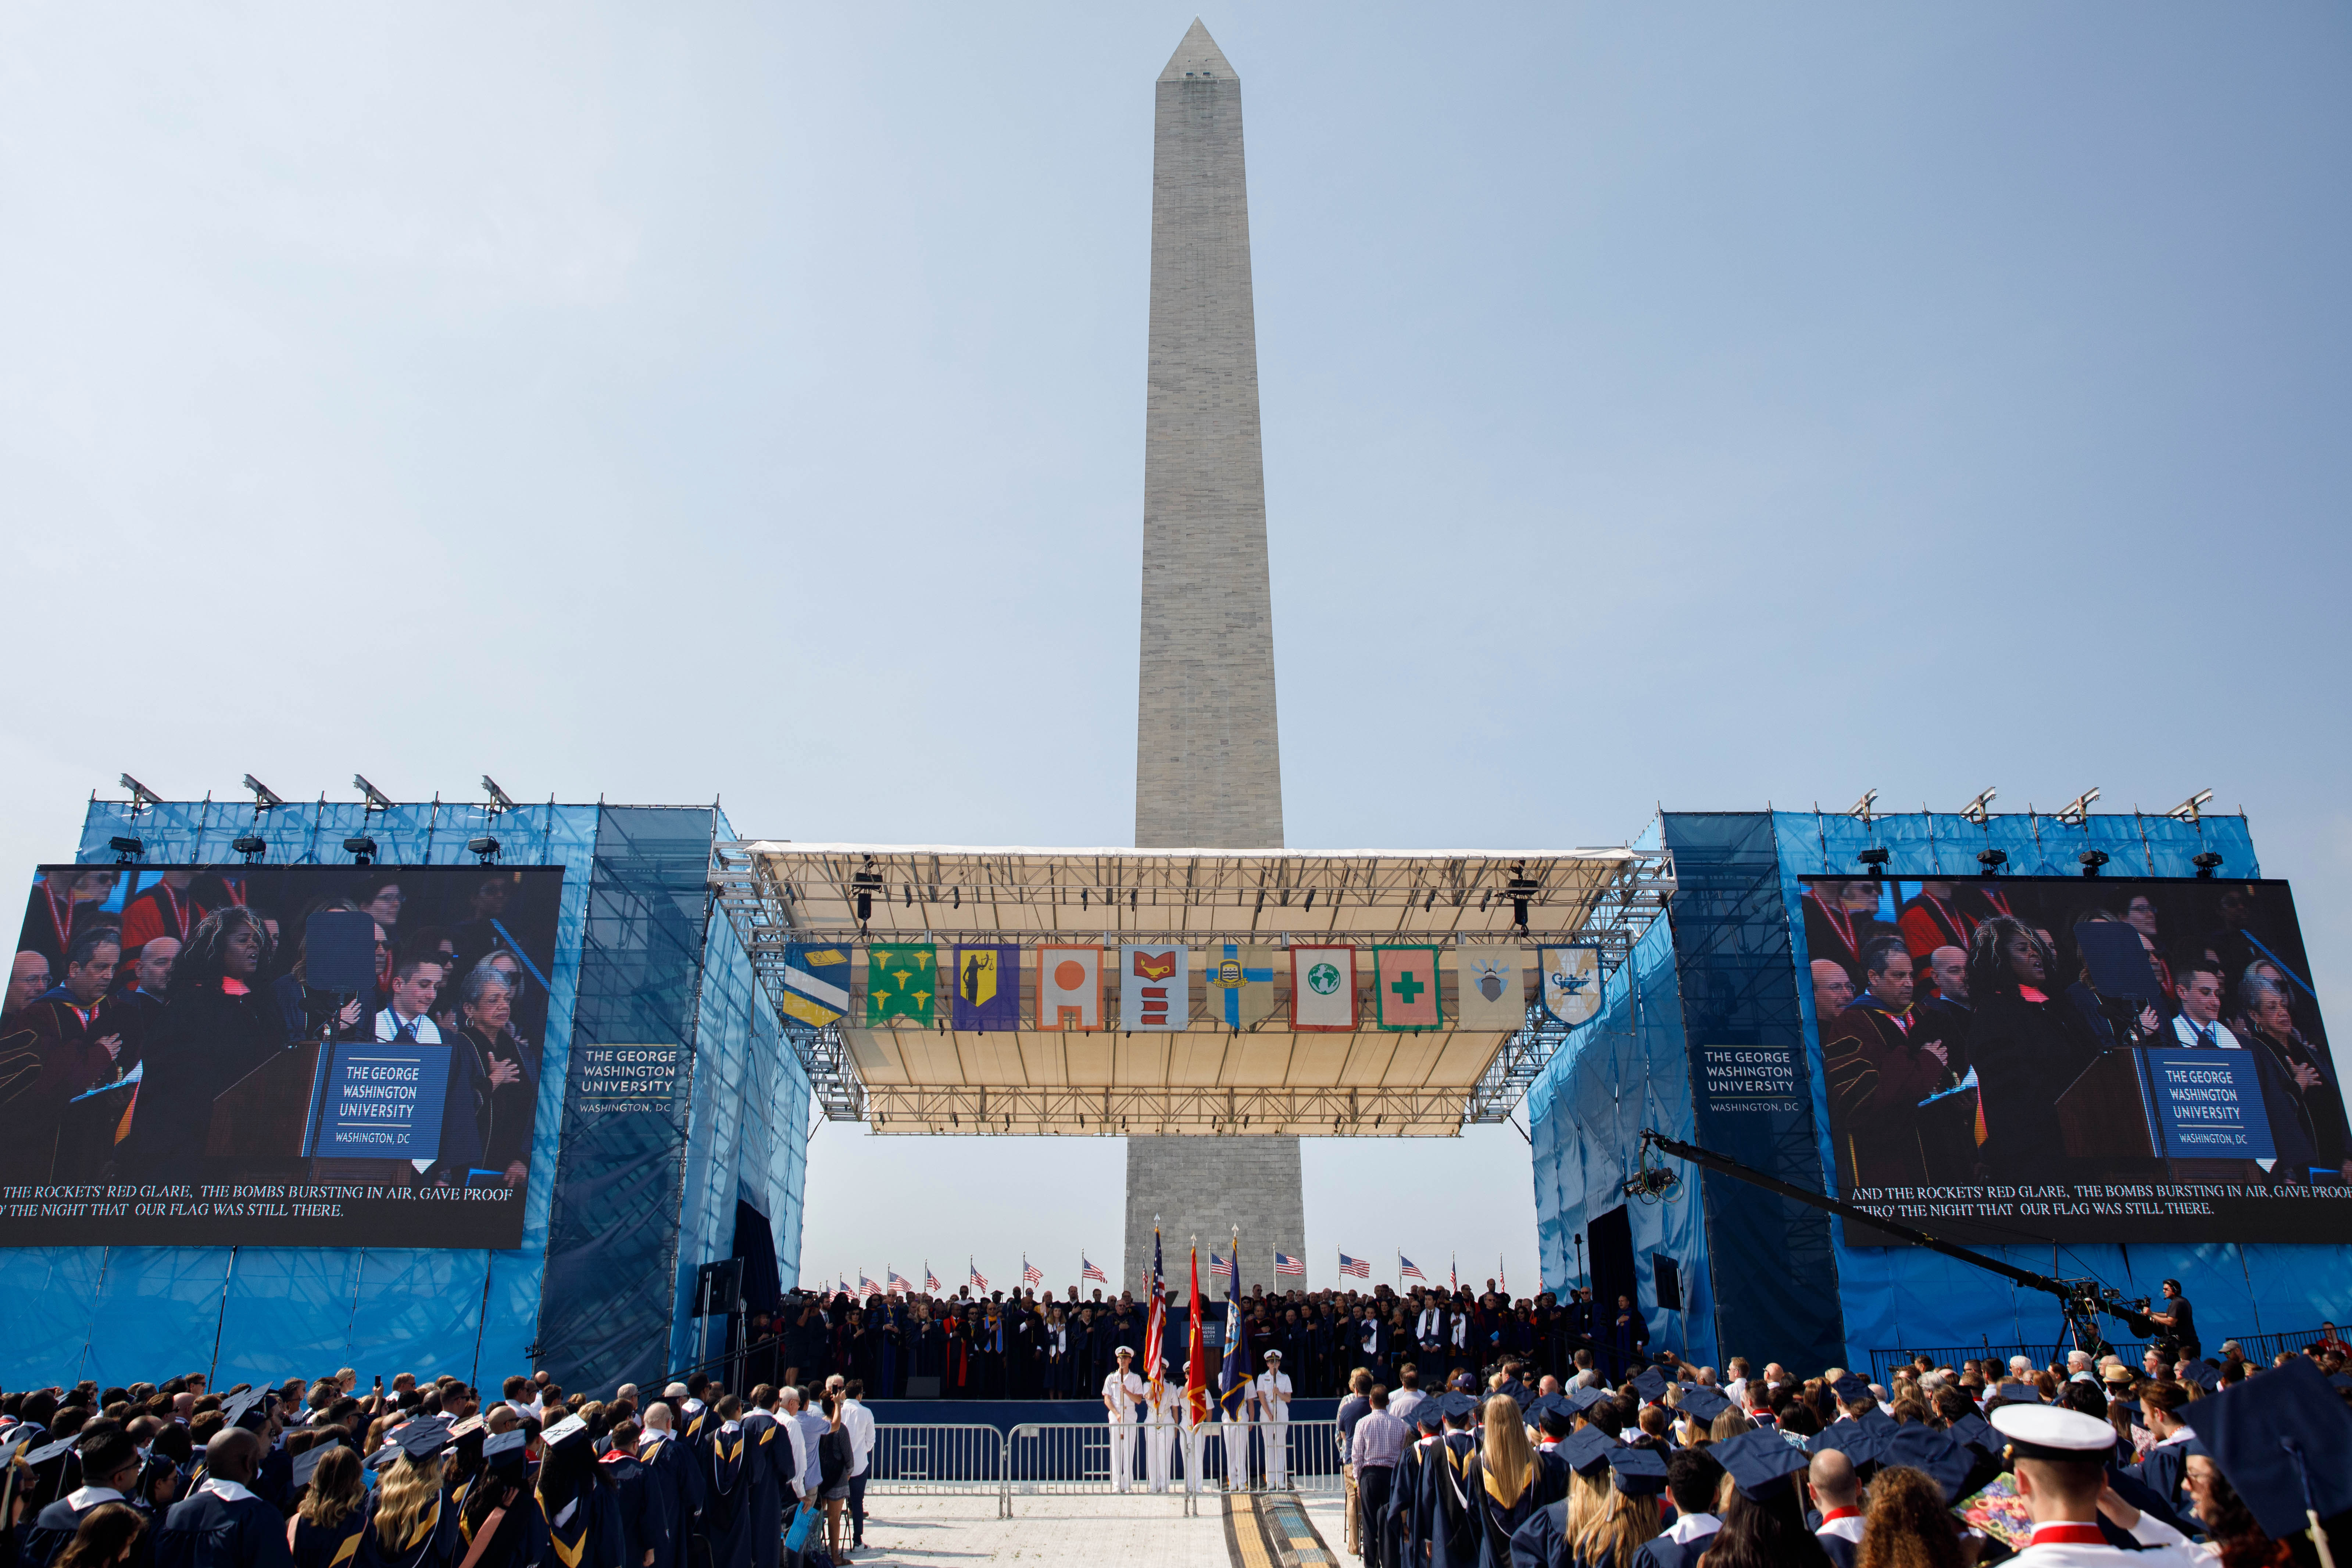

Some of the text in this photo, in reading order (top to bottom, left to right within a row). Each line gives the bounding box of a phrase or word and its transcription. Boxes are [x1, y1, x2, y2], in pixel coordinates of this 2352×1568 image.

[586, 1051, 677, 1062] THE GEORGE
[1704, 1052, 1790, 1062] THE GEORGE
[347, 1067, 419, 1081] THE GEORGE
[584, 1065, 675, 1077] WASHINGTON
[1706, 1066, 1792, 1077] WASHINGTON
[2165, 1070, 2233, 1084] THE GEORGE
[344, 1085, 417, 1099] WASHINGTON
[582, 1081, 673, 1092] UNIVERSITY
[1708, 1081, 1794, 1092] UNIVERSITY
[2169, 1088, 2238, 1101] WASHINGTON
[340, 1103, 414, 1118] UNIVERSITY
[580, 1103, 671, 1112] WASHINGTON, DC
[1710, 1103, 1799, 1112] WASHINGTON, DC
[2173, 1106, 2240, 1119] UNIVERSITY
[336, 1132, 410, 1145] WASHINGTON, DC
[2179, 1133, 2248, 1145] WASHINGTON, DC
[3, 1185, 513, 1201] THE ROCKETS' RED GLARE, THE BOMBS BURSTING IN AIR, GAVE PROOF
[1852, 1185, 2352, 1200] AND THE ROCKETS' RED GLARE, THE BOMBS BURSTING IN AIR, GAVE PROOF
[10, 1204, 38, 1217] THE
[41, 1204, 88, 1216] NIGHT
[91, 1203, 129, 1215] THAT
[135, 1203, 165, 1215] OUR
[169, 1203, 209, 1215] FLAG
[214, 1203, 244, 1215] WAS
[247, 1203, 288, 1216] STILL
[292, 1204, 343, 1217] THERE.
[1898, 1205, 1927, 1217] THE
[1930, 1204, 1974, 1216] NIGHT
[1977, 1204, 2013, 1215] THAT
[2020, 1203, 2051, 1215] OUR
[2053, 1203, 2090, 1215] FLAG
[2092, 1203, 2122, 1214] WAS
[2125, 1203, 2163, 1214] STILL
[2165, 1203, 2214, 1214] THERE.
